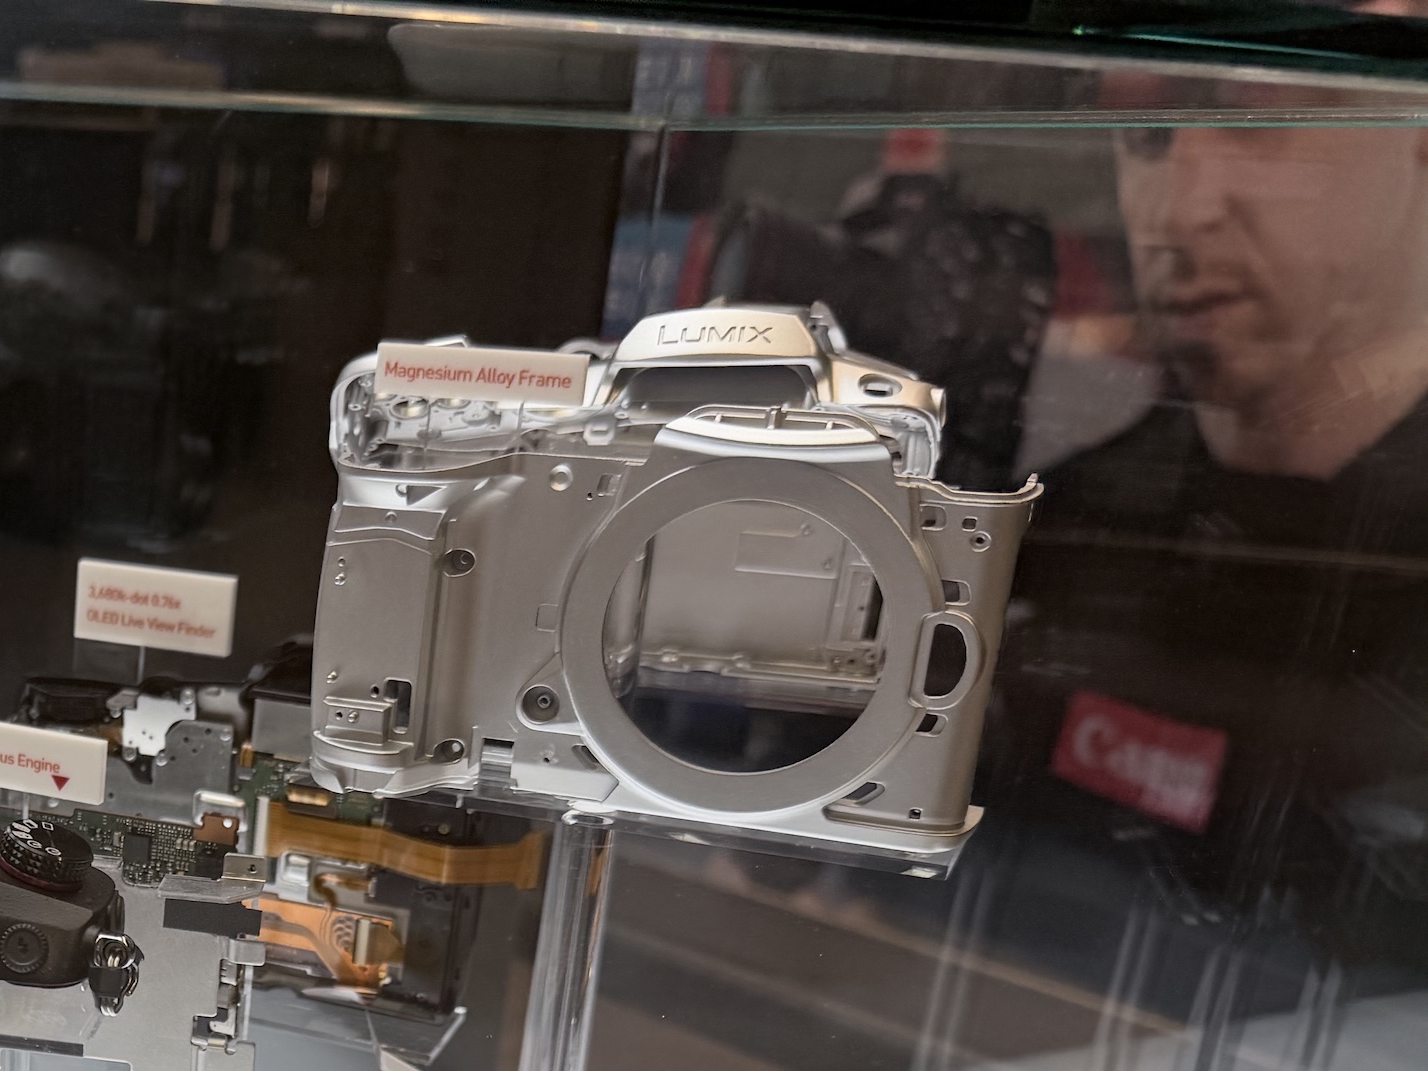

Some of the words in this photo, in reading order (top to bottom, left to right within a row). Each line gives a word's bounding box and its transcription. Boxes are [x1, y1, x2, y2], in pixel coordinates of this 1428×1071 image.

[657, 325, 773, 345] LUMIX
[384, 361, 472, 383] Magnesium
[476, 368, 516, 389] Alloy
[518, 371, 572, 389] Frame
[121, 614, 145, 629] Live
[147, 618, 175, 633] View
[177, 622, 216, 638] Finder
[18, 753, 60, 774] Engine
